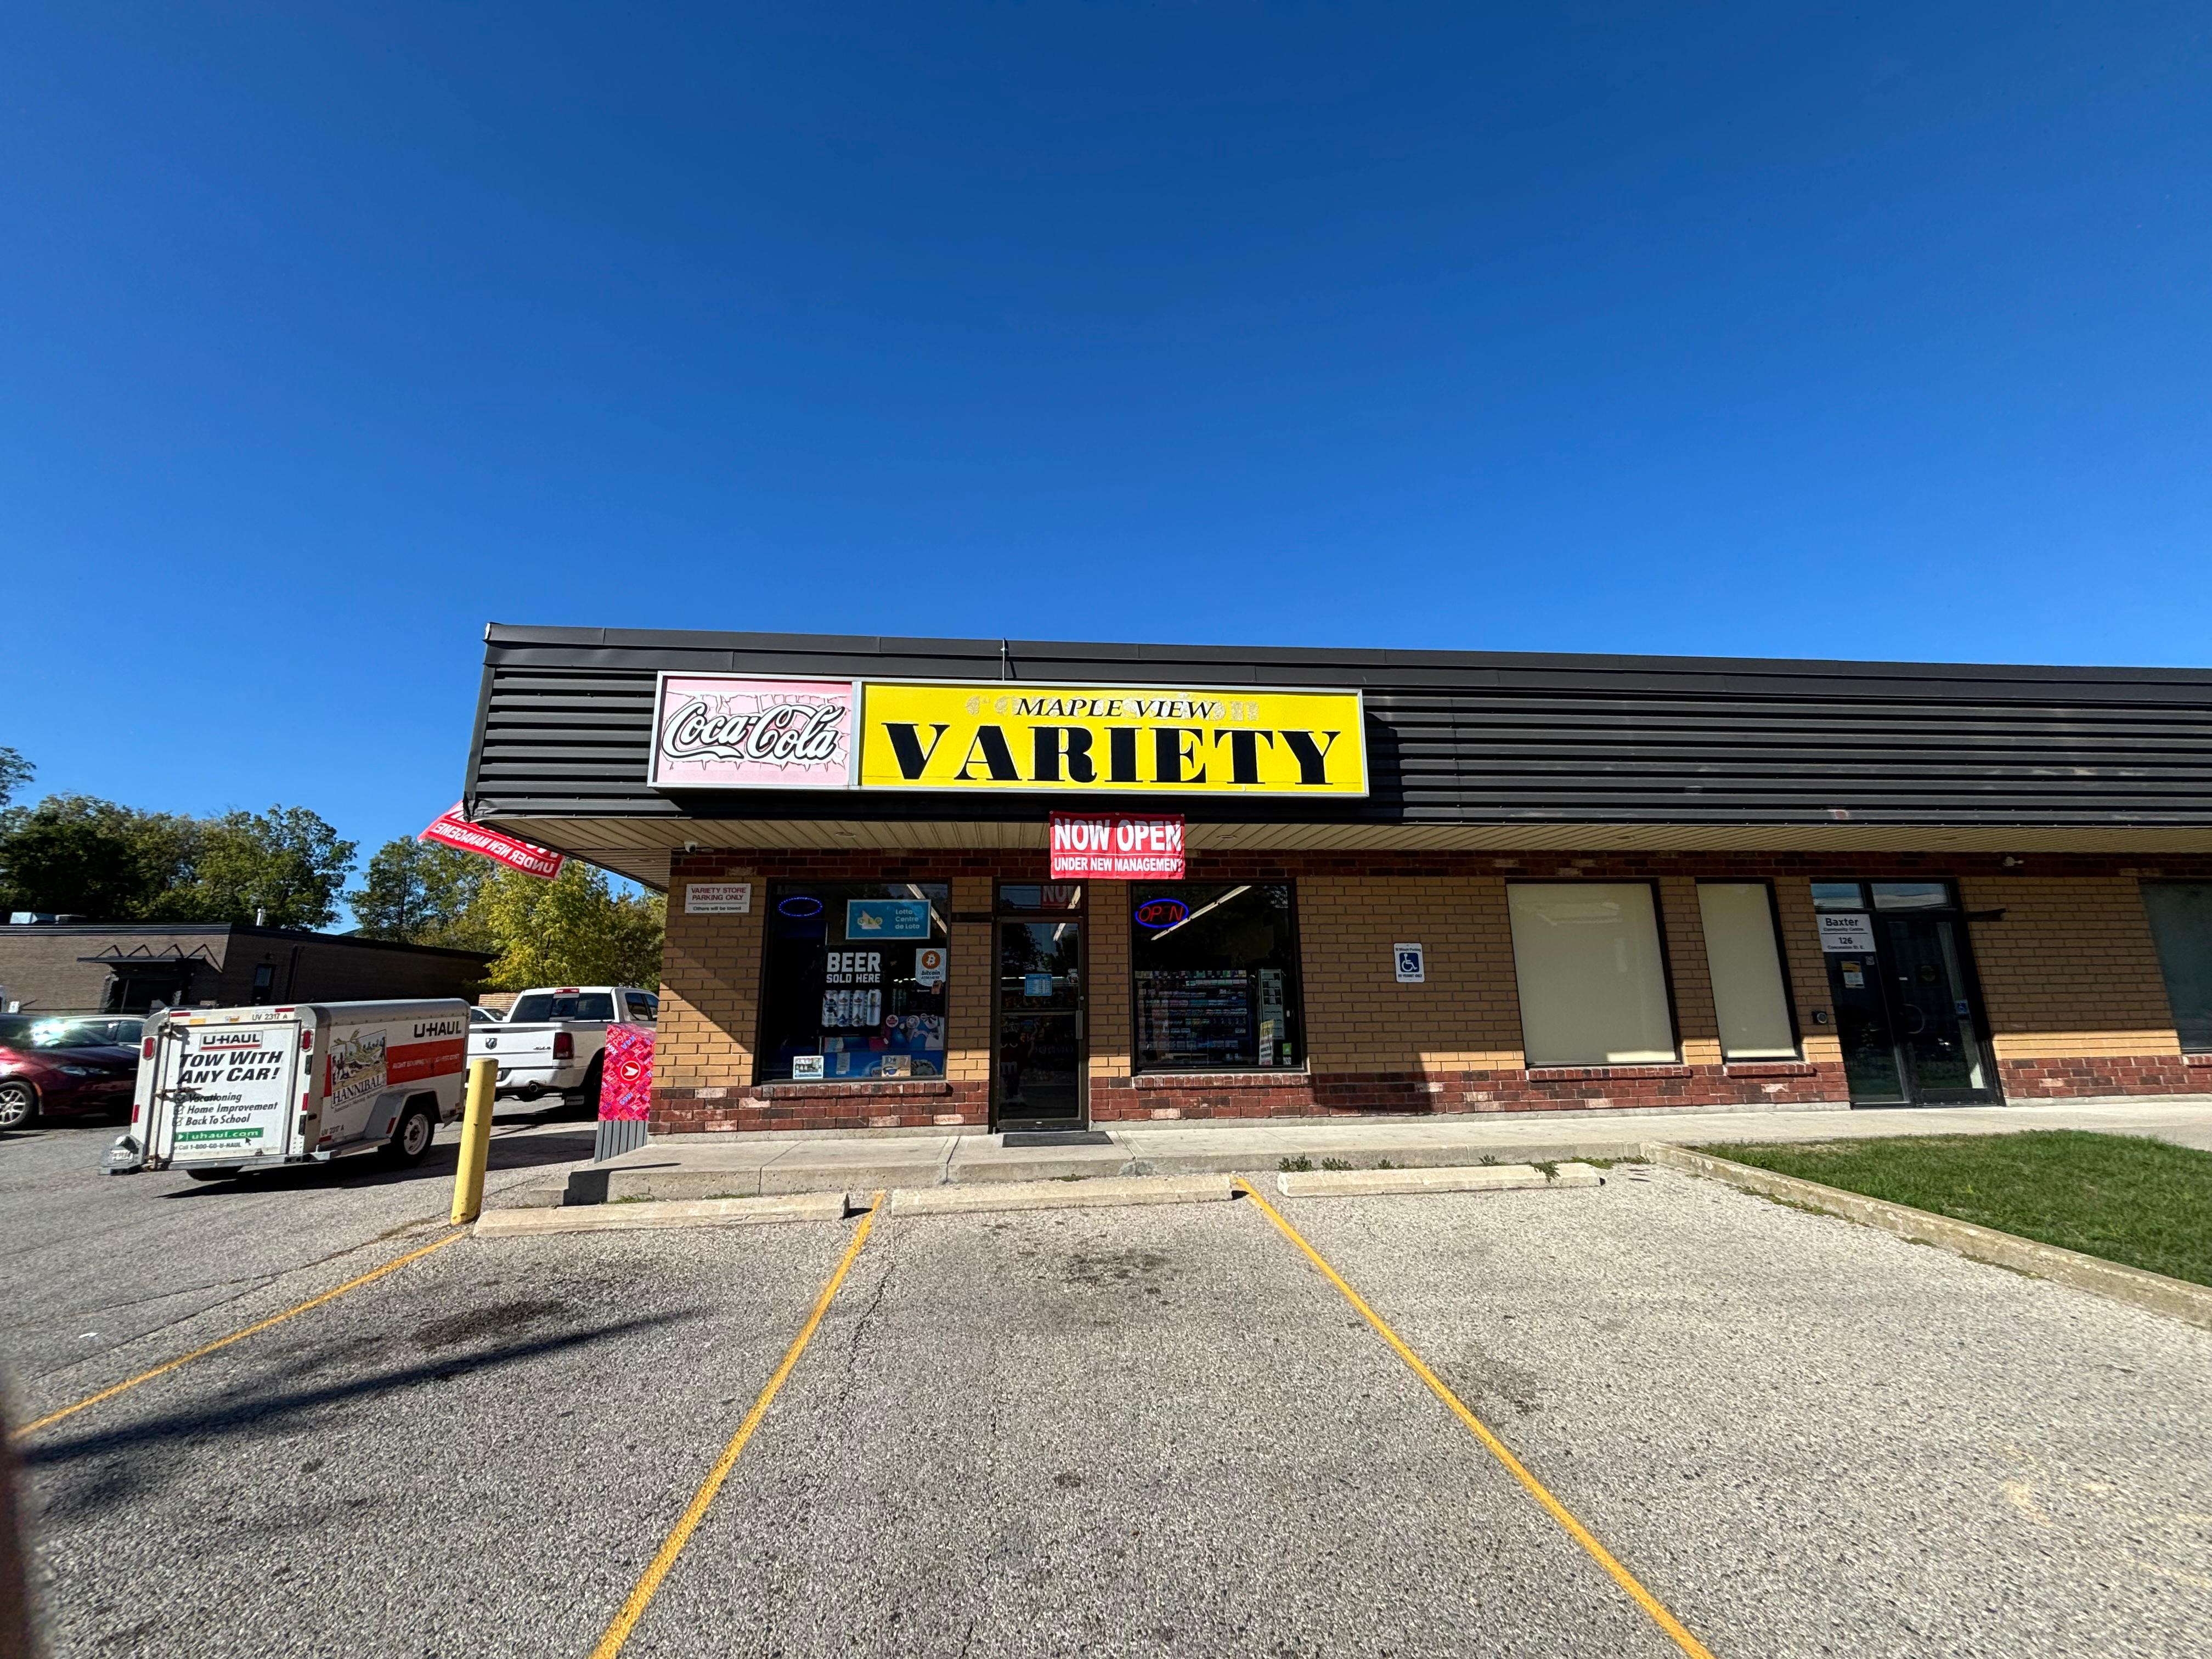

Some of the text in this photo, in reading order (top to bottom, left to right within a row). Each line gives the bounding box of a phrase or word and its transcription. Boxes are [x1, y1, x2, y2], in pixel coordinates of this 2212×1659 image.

[1015, 698, 1122, 717] MAPLE
[1136, 701, 1217, 719] VIEW
[663, 701, 848, 760] Coca-Cola
[881, 722, 1341, 785] VARIETY
[1054, 818, 1182, 852] NOW OPEN
[1054, 857, 1183, 872] UNDER NEW MANAGEMENT
[827, 952, 881, 972] BEER
[826, 973, 881, 983] SOLD HERE
[414, 1021, 461, 1038] U-HAUL
[203, 1034, 259, 1045] U-HAUL
[180, 1051, 284, 1068] TOW WITH
[177, 1068, 280, 1084] ANY CAR!
[332, 1075, 381, 1104] HANNIBAL
[187, 1102, 278, 1114] Home Improvement
[185, 1114, 251, 1125] Back To School
[191, 1131, 259, 1141] uhaul.com
